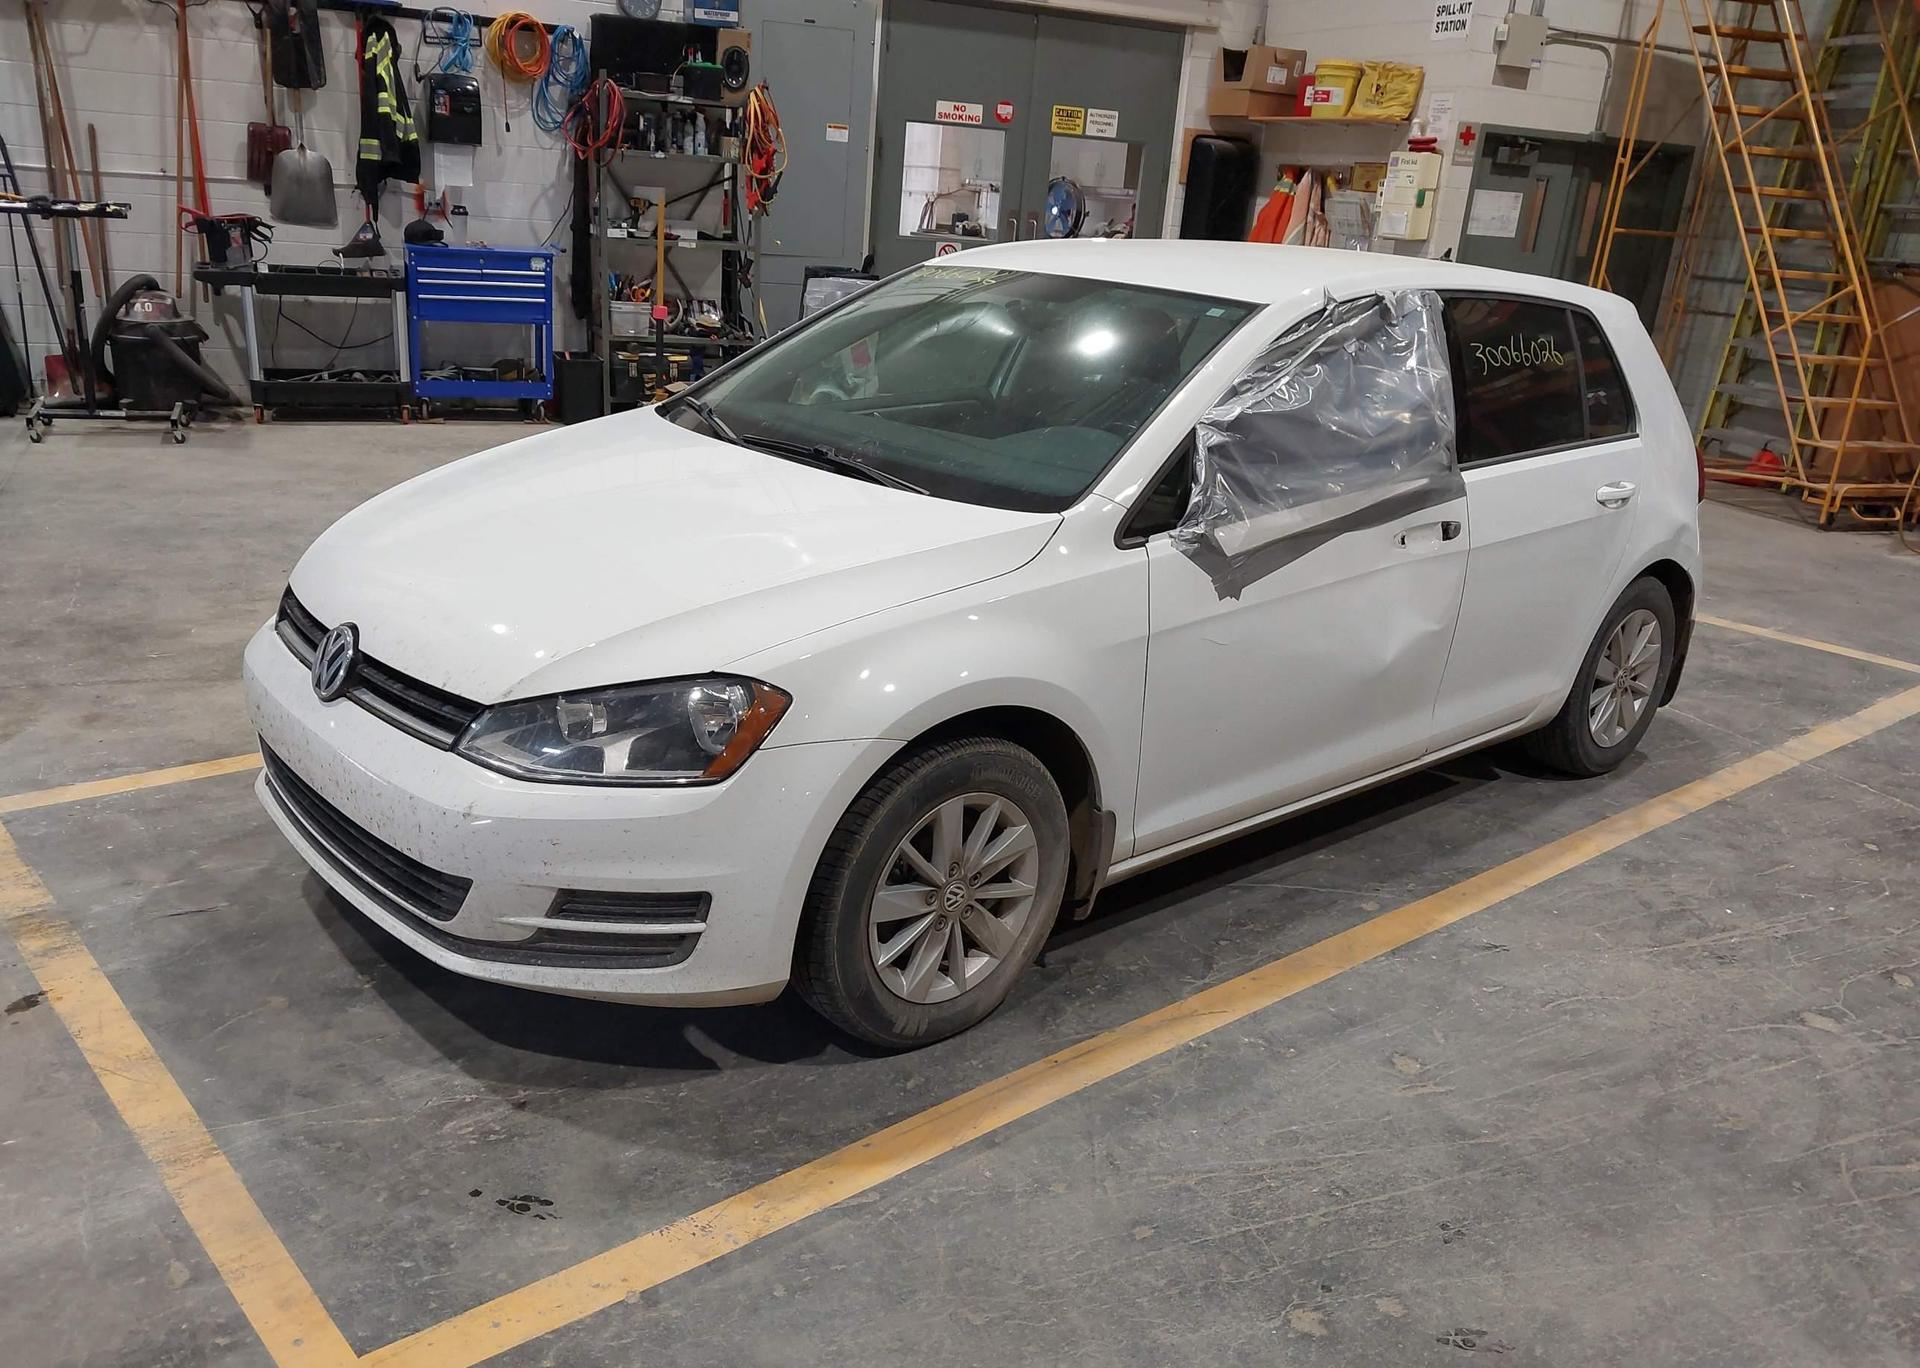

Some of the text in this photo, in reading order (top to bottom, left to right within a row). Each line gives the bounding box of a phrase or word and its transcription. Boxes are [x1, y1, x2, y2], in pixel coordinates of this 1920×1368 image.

[1436, 2, 1472, 17] SPILL-KIT
[1435, 19, 1467, 33] STATION
[953, 104, 967, 113] NO
[1055, 108, 1082, 119] CAUTION
[937, 111, 981, 123] SMOKING
[1470, 332, 1564, 375] 30066026
